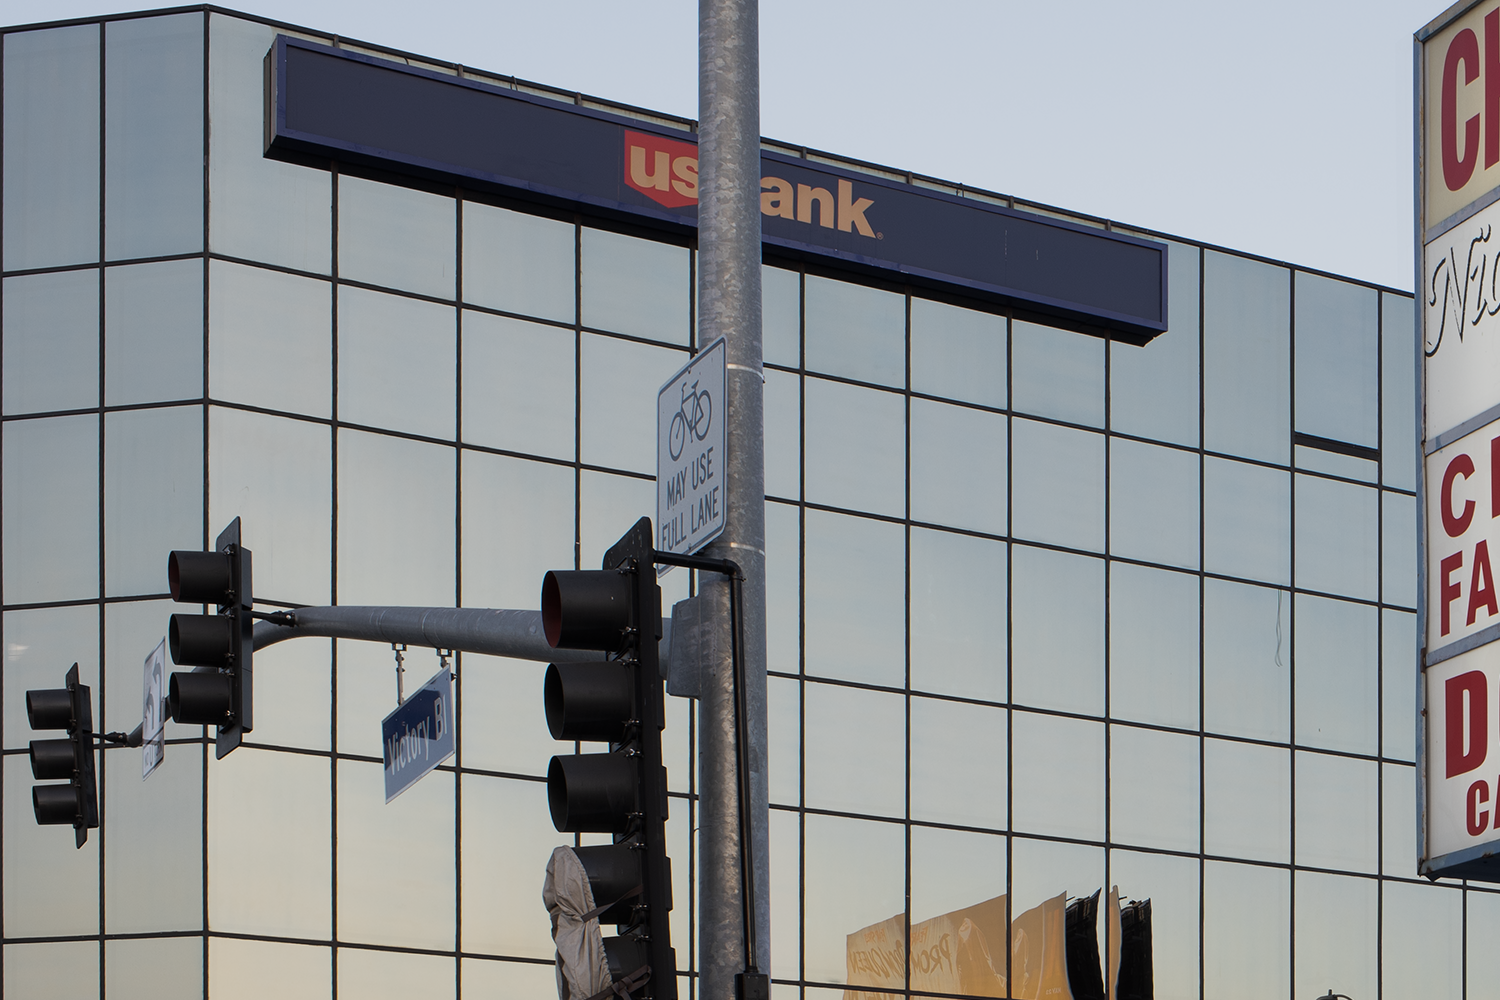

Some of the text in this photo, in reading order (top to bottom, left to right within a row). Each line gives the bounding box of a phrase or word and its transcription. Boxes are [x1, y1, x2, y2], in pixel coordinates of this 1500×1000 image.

[760, 176, 877, 240] ank
[666, 446, 714, 511] MAY USE
[662, 485, 719, 552] FULL LANE
[387, 694, 448, 776] Victory Bl
